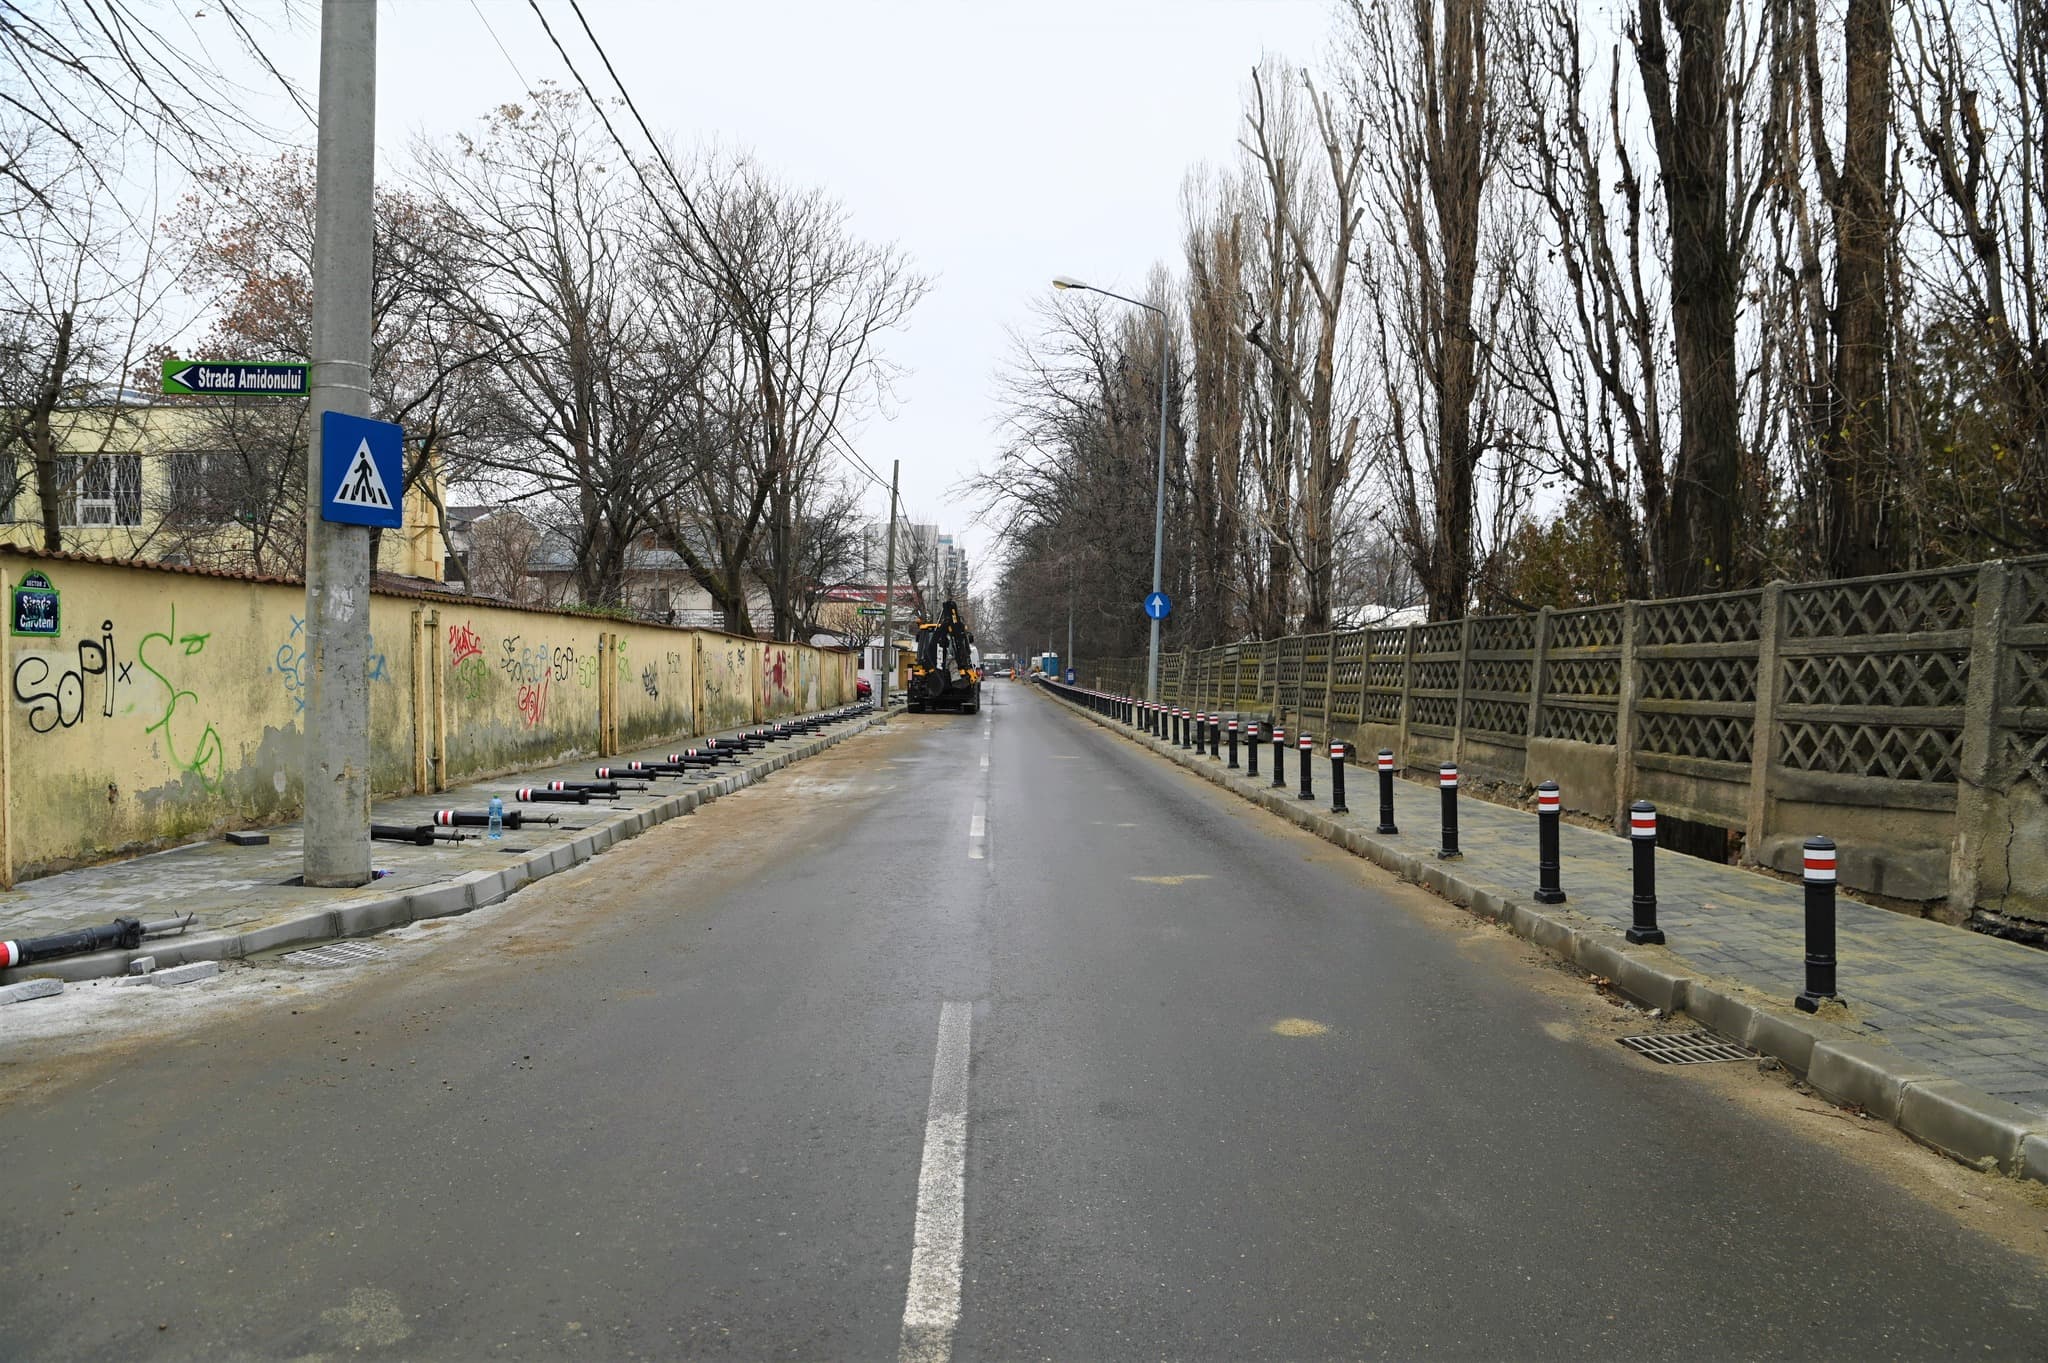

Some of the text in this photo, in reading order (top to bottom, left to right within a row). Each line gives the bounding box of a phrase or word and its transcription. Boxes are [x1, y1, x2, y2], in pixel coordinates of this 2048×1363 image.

[198, 366, 302, 390] Strada Amidonului
[22, 595, 51, 610] Strada
